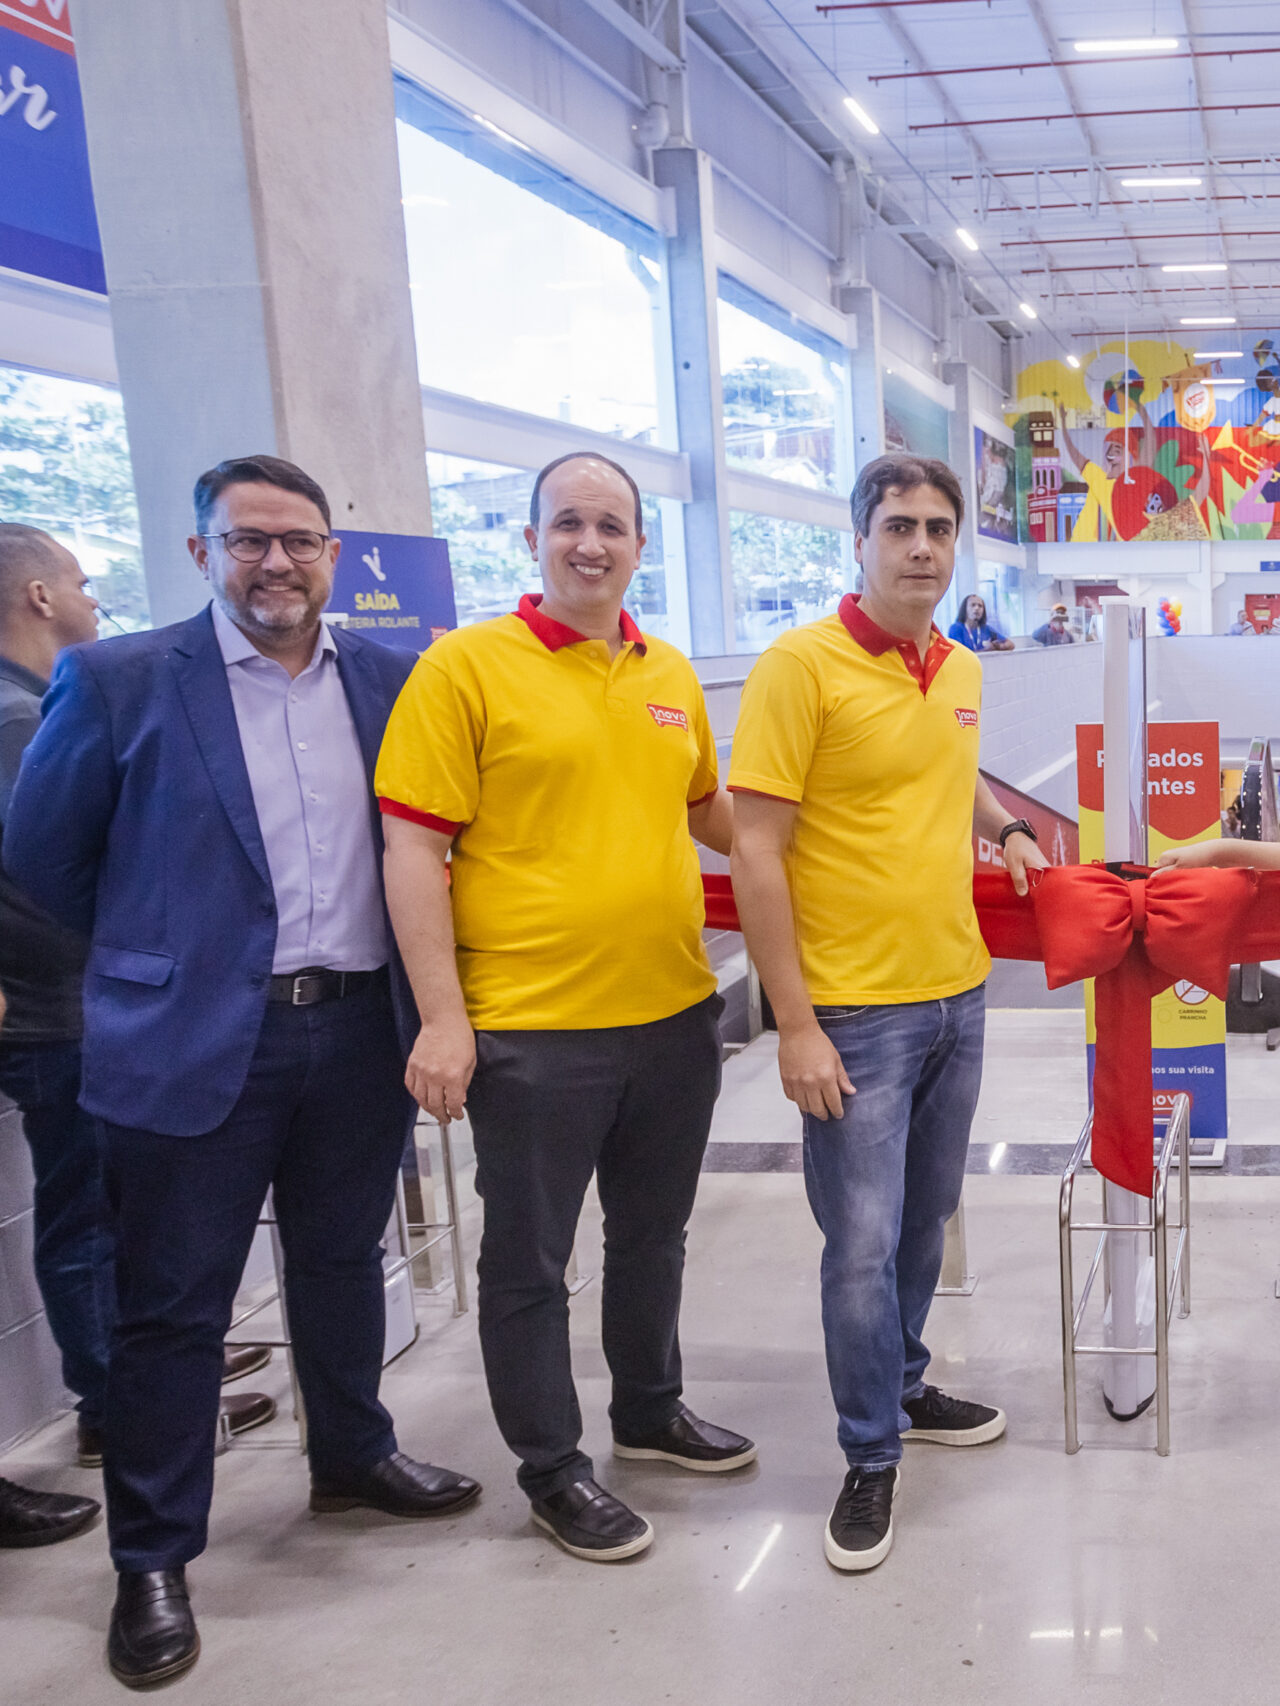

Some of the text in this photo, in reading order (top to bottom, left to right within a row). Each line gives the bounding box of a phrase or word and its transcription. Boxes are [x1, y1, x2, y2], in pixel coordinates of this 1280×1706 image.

[354, 589, 400, 610] SAÍDA
[378, 616, 419, 628] ROLANTE
[1188, 1065, 1215, 1074] visita
